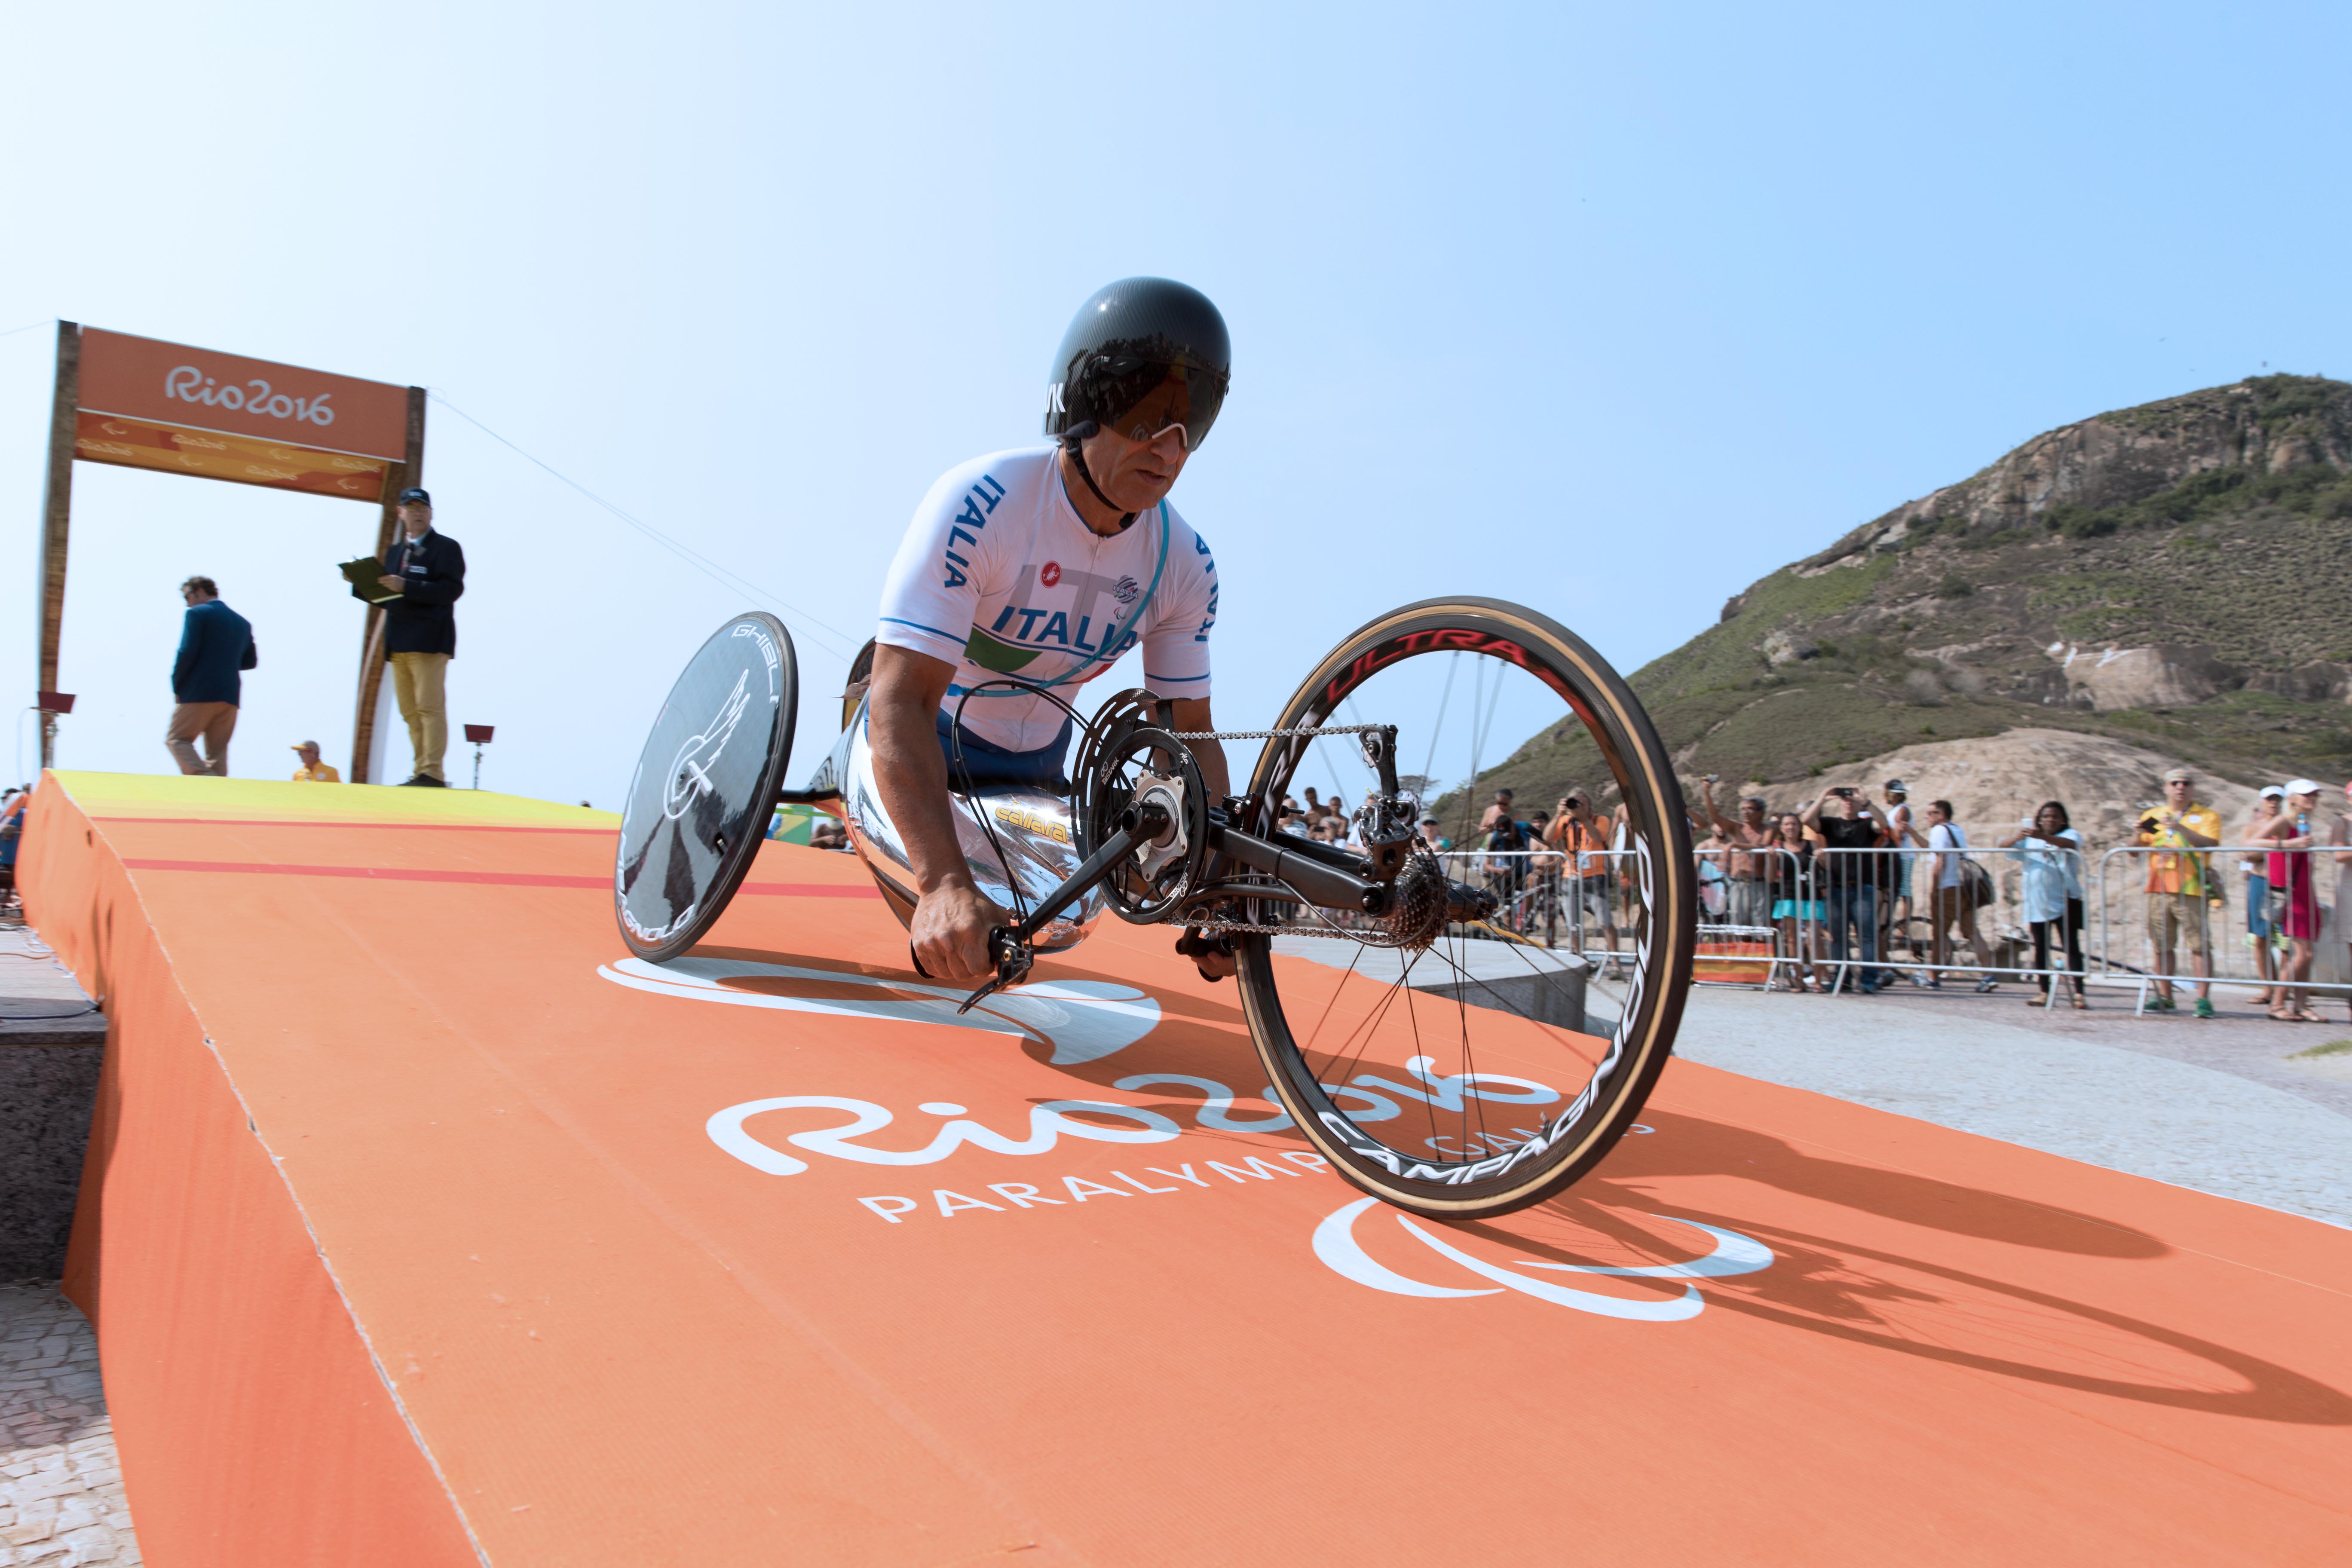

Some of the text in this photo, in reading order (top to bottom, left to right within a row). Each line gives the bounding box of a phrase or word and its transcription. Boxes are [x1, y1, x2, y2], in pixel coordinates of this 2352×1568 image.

[165, 366, 334, 426] Rio2016
[944, 474, 1006, 588] ITALIA
[1112, 585, 1139, 599] ITALIA
[732, 625, 780, 705] GHIBLI
[991, 605, 1138, 656] ITALIA
[1327, 629, 1528, 703] ULTRA
[1102, 756, 1119, 786] BISTARK
[1317, 830, 1654, 1185] CAMPAGNOLO
[706, 1056, 1561, 1176] Rio2016
[856, 1152, 1328, 1223] PARALYMP
